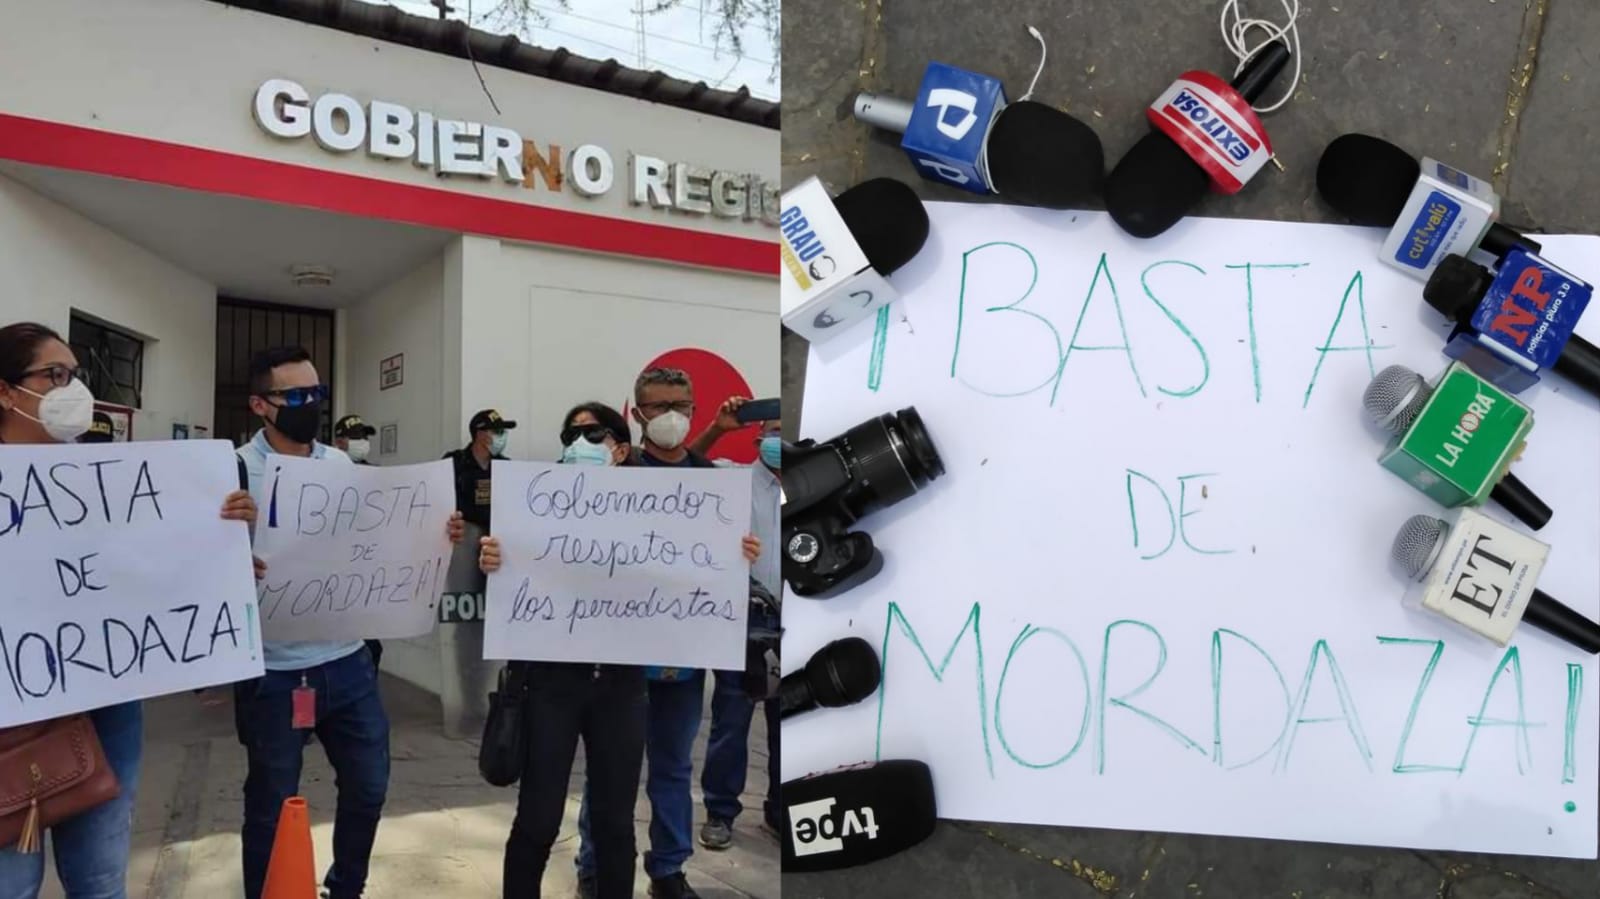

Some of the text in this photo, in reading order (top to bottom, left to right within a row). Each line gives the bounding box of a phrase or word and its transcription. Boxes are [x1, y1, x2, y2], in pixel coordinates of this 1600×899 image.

[253, 78, 614, 197] GOBIERNO
[1173, 91, 1250, 161] EXITOSA
[1490, 266, 1550, 347] NP
[1527, 321, 1549, 354] noticias
[1546, 298, 1562, 322] piura
[1435, 441, 1464, 468] LA
[1126, 468, 1237, 560] DE
[55, 552, 108, 597] DE
[350, 543, 379, 562] DE
[534, 530, 726, 578] respeto a
[1450, 534, 1517, 619] ET
[508, 577, 737, 634] los periodistas
[795, 804, 879, 844] tvpe
